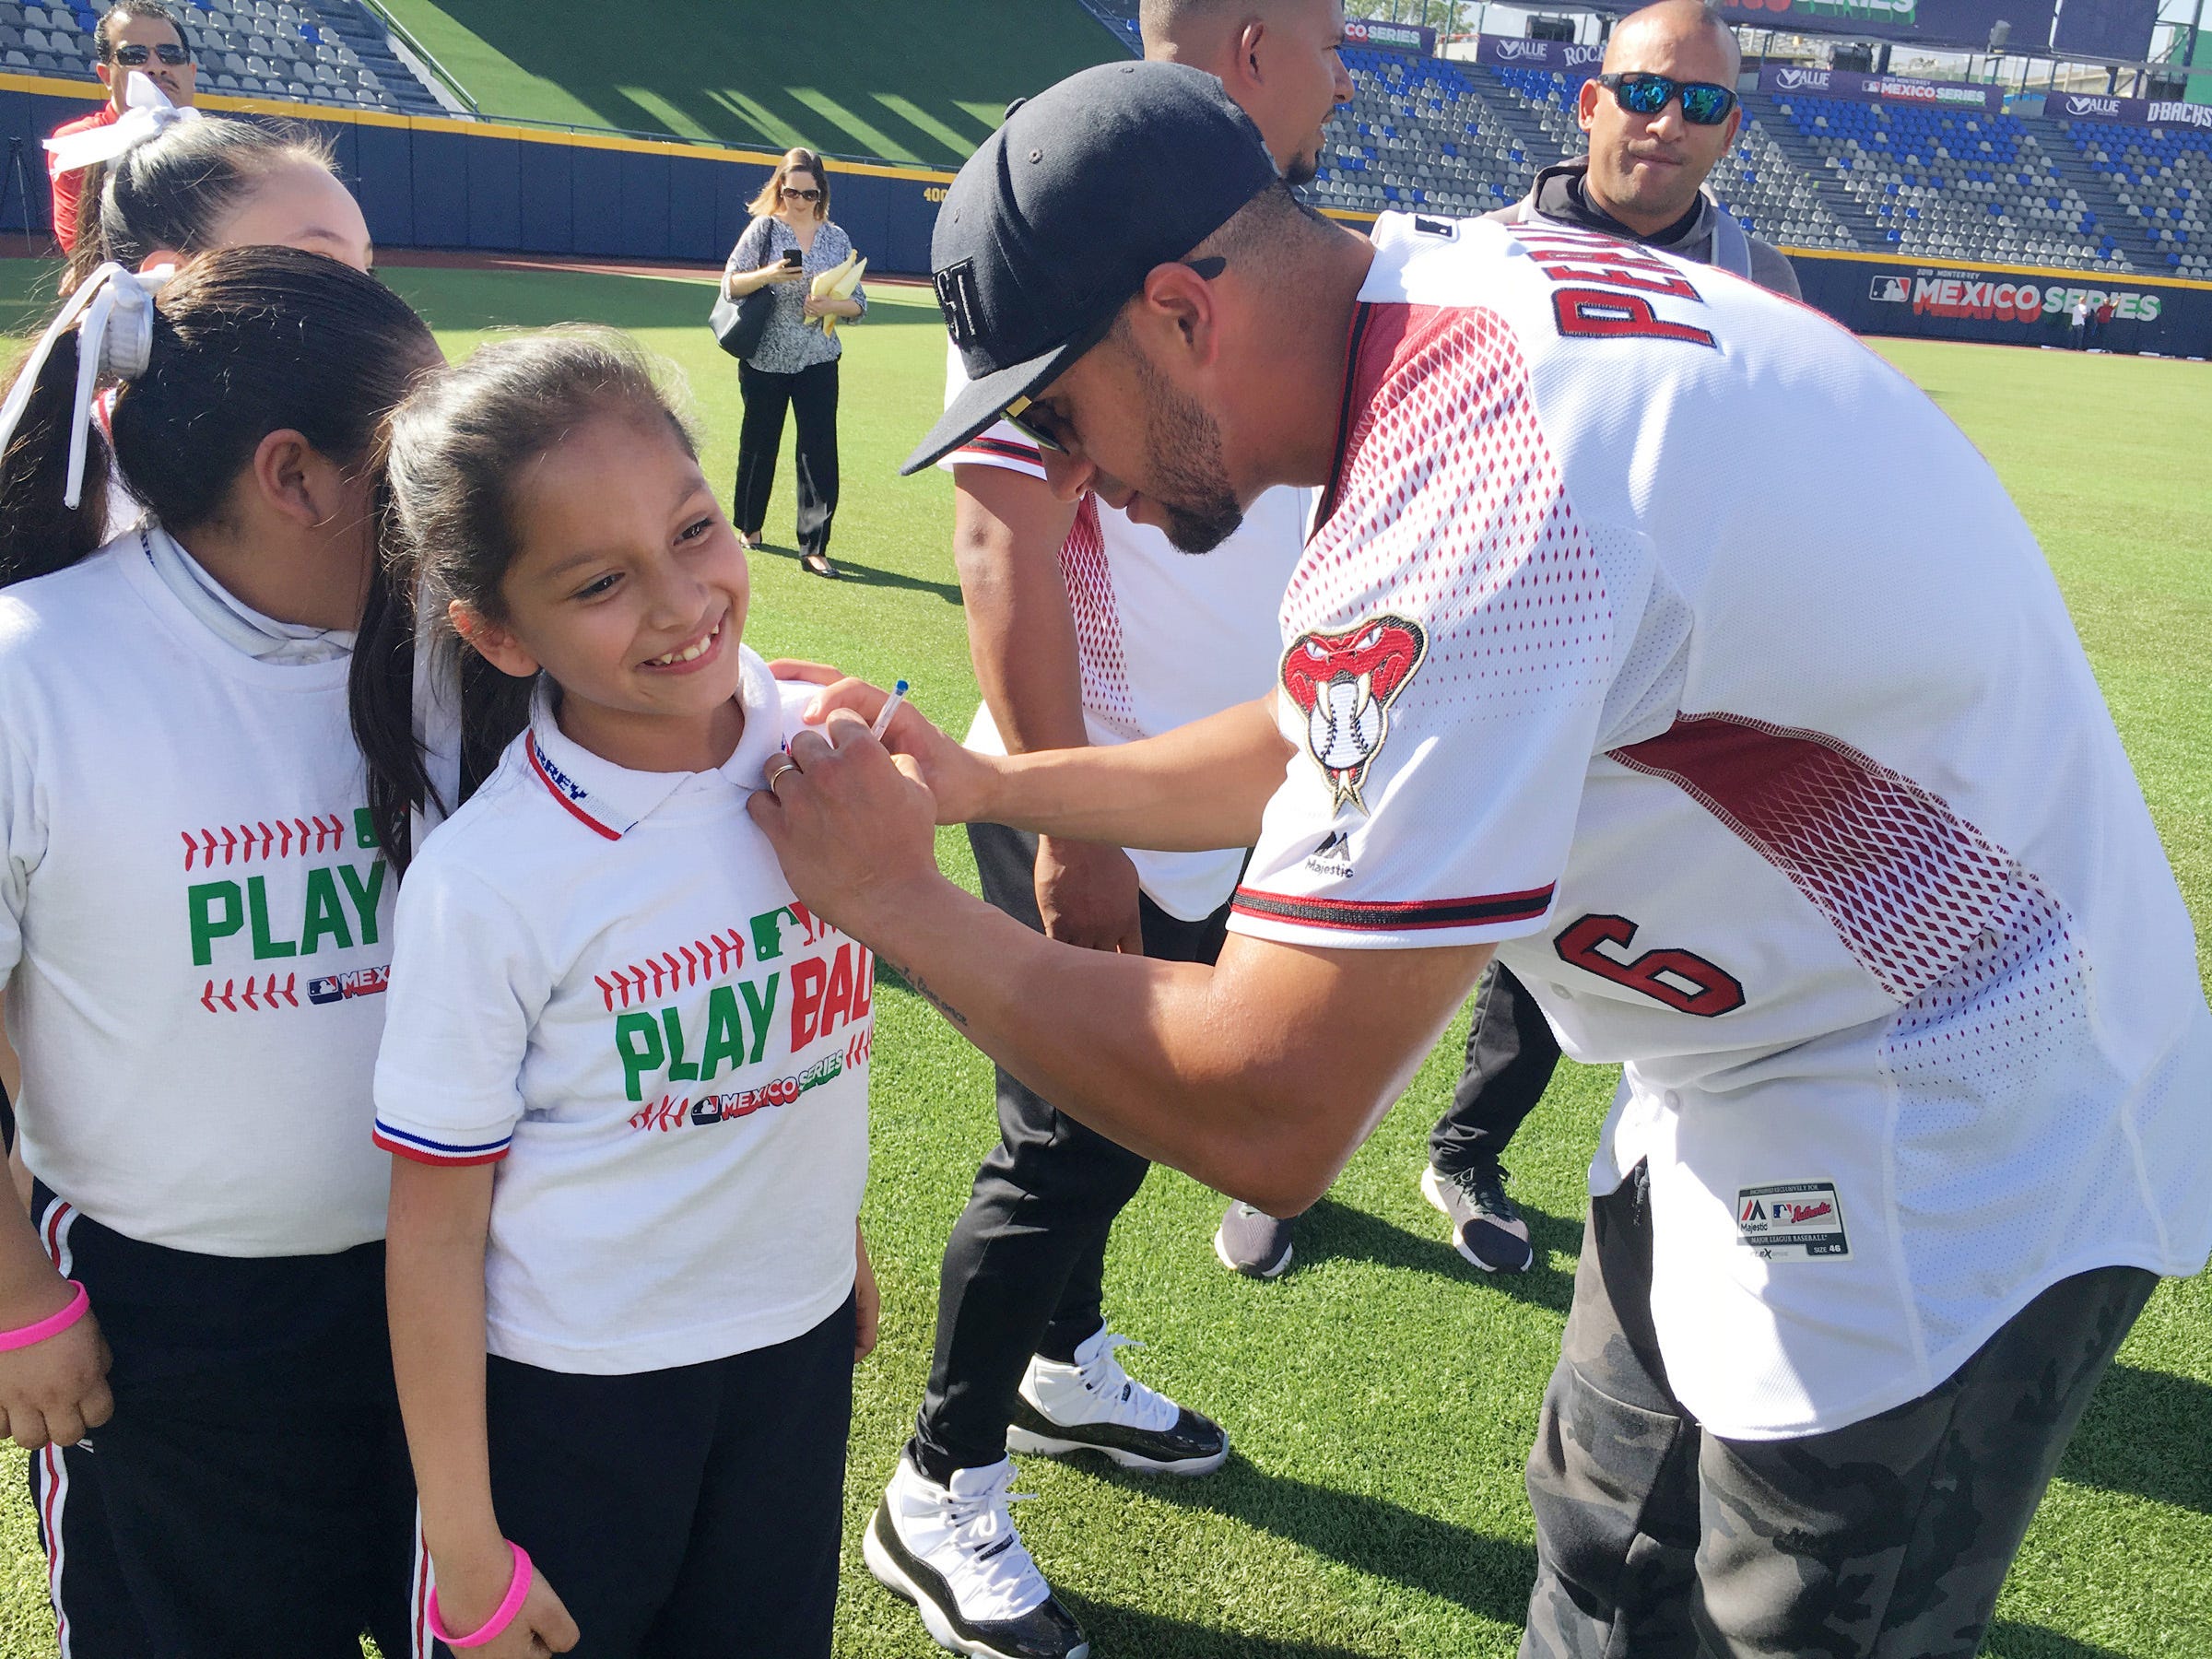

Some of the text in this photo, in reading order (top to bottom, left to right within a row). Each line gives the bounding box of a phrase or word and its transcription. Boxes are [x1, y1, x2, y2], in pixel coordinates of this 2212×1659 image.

[1368, 26, 1421, 44] SERIES
[1497, 40, 1548, 58] VALUE
[1777, 68, 1830, 88] VALUE
[1881, 83, 1986, 103] MEXICO SERIES
[2066, 97, 2121, 114] VALUE
[1913, 277, 2161, 322] MEXICO SERIES
[535, 738, 588, 800] RREY
[1305, 858, 1354, 878] Majestic
[188, 860, 386, 966] PLAY
[1553, 913, 1747, 1018] 6
[616, 971, 781, 1101] PLAY
[791, 943, 874, 1053] BAL
[721, 1050, 843, 1119] MEXICO SERIES
[1741, 1222, 1768, 1234] Majestic
[1770, 1235, 1792, 1243] LEAGUE
[1793, 1234, 1827, 1242] BASEBALL
[1829, 1244, 1841, 1253] 46
